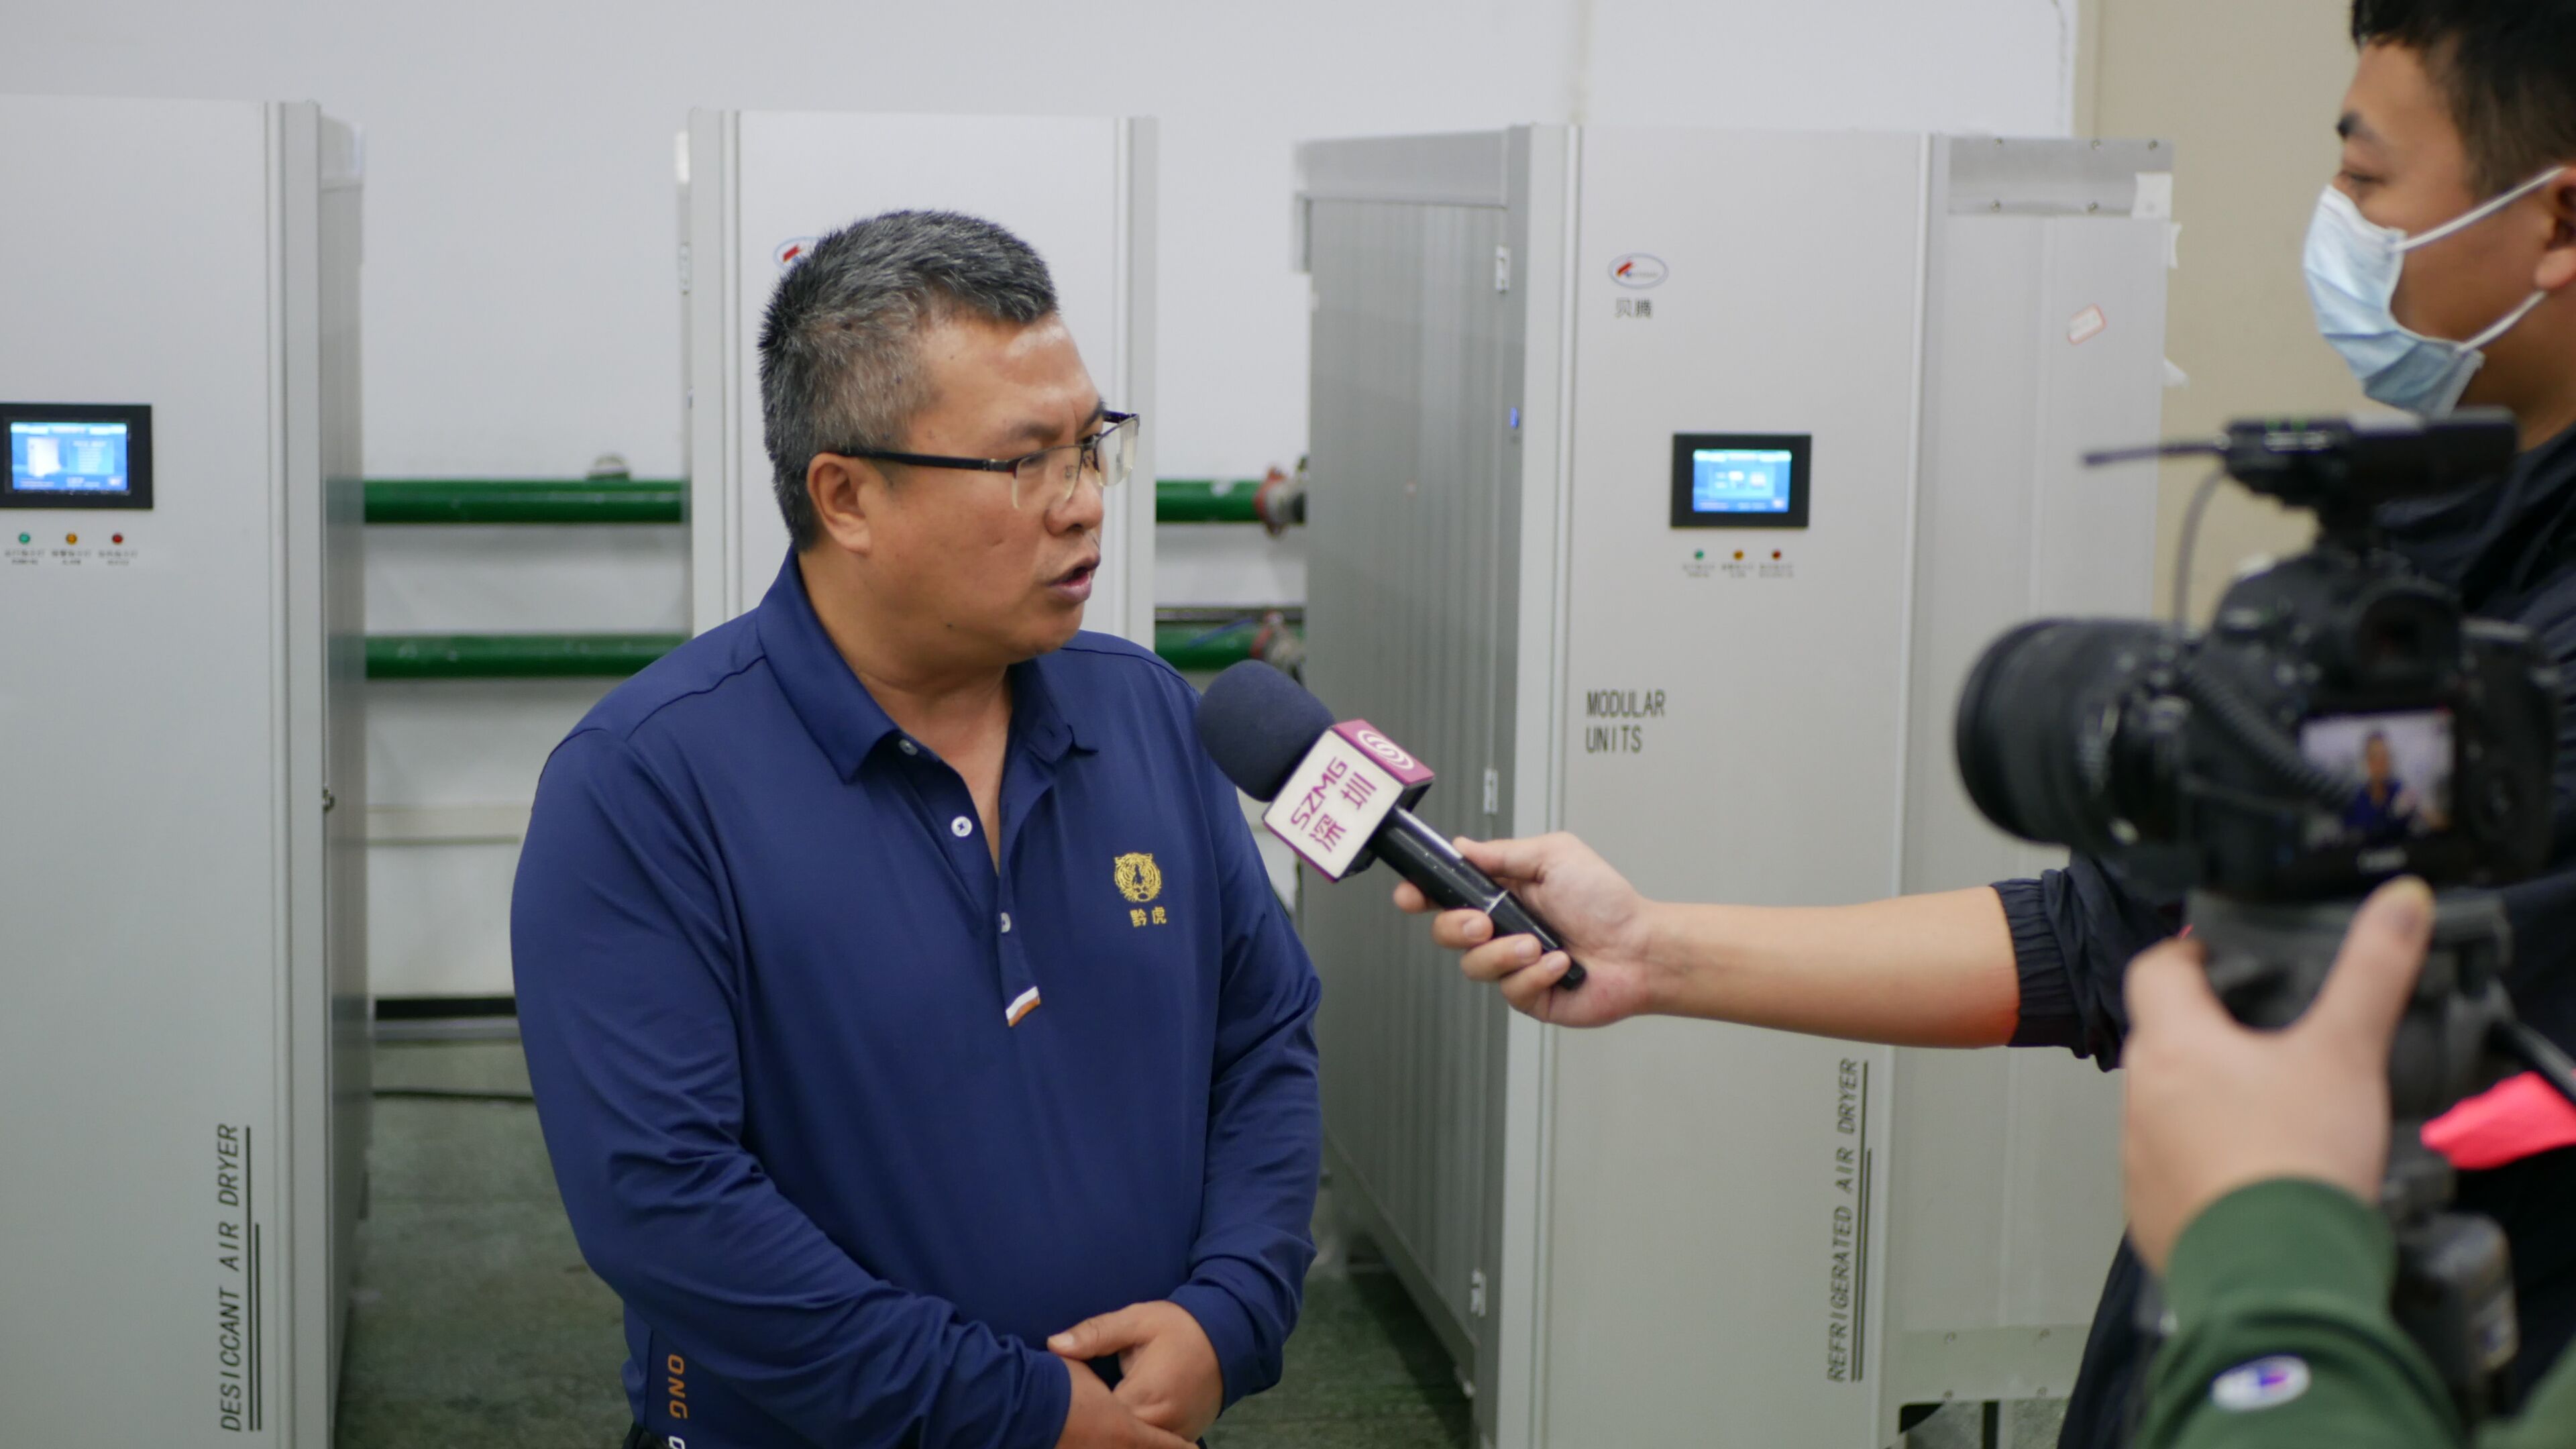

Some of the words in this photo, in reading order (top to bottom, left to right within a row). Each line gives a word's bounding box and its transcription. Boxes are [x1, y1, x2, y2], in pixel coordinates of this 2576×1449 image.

[1586, 724, 1642, 753] UNITS
[1587, 689, 1666, 718] MODULAR
[1290, 757, 1348, 830] SZMG
[1309, 771, 1377, 853] 深圳
[1130, 906, 1167, 928] 黔虎
[1837, 1058, 1857, 1135] DRYER
[217, 1124, 239, 1207] DRYER
[1835, 1146, 1854, 1194] AIR
[219, 1222, 240, 1272] AIR
[1827, 1205, 1854, 1383] REFRIGERATED
[219, 1286, 241, 1432] DESICCANT
